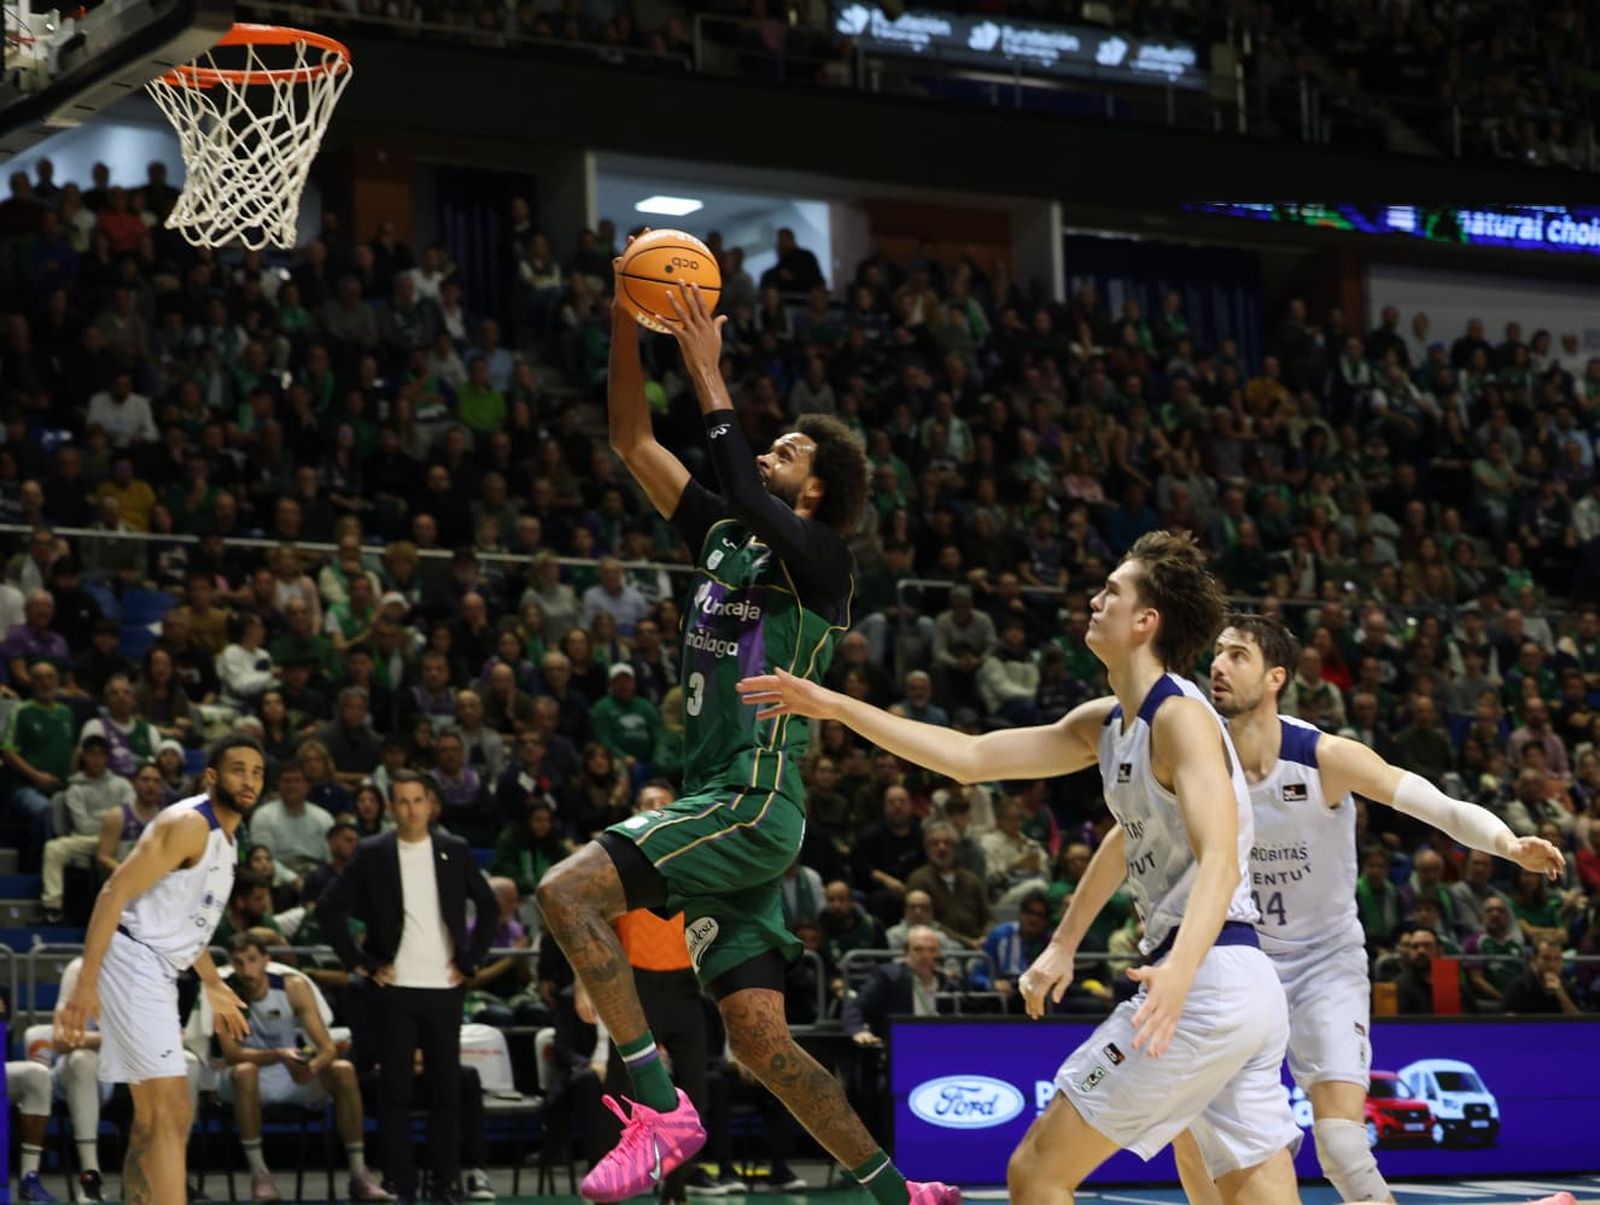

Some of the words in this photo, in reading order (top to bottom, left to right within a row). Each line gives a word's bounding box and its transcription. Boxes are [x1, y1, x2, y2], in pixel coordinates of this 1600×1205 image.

[1546, 213, 1600, 245] choi
[686, 671, 705, 717] 3
[1250, 845, 1308, 861] ROBITAS
[934, 1084, 1000, 1116] Ford
